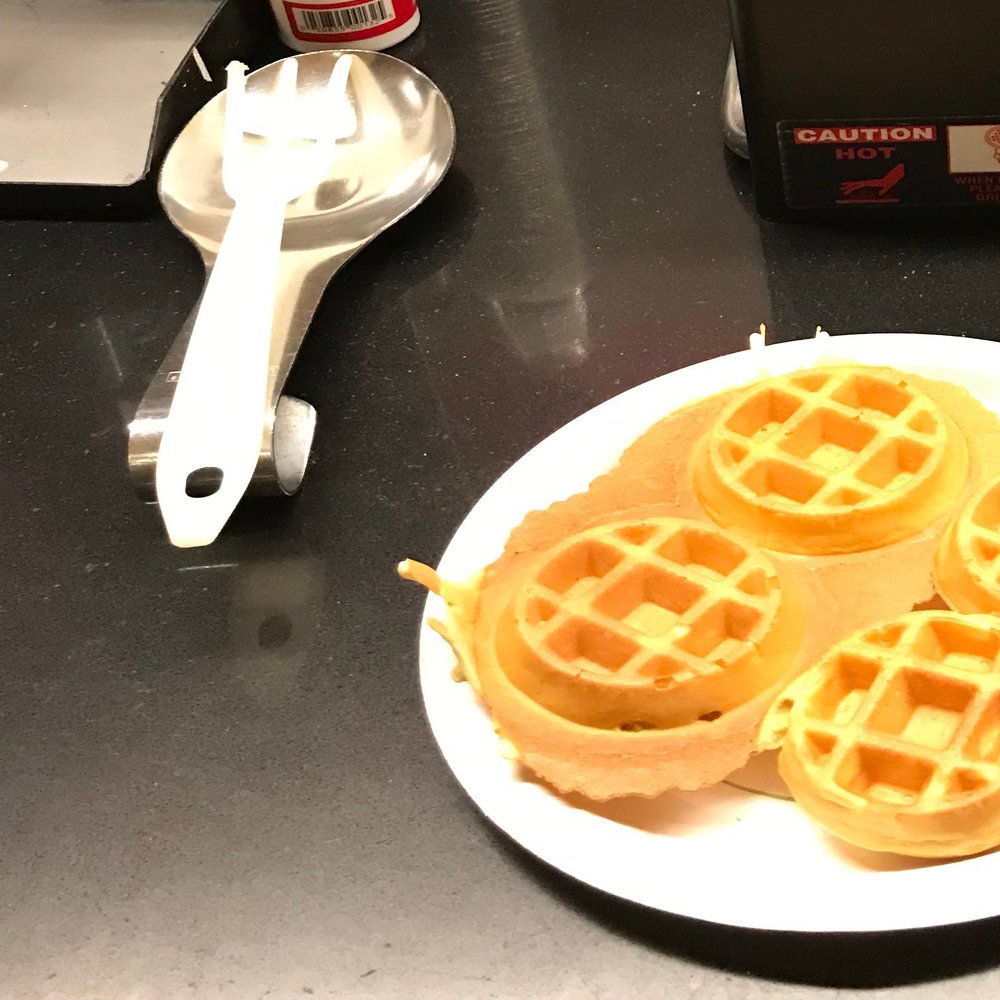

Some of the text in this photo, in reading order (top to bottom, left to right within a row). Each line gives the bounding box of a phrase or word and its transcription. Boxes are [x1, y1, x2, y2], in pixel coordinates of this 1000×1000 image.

[797, 126, 933, 143] CAUTION
[835, 147, 897, 160] HOT
[953, 176, 993, 184] WHEN
